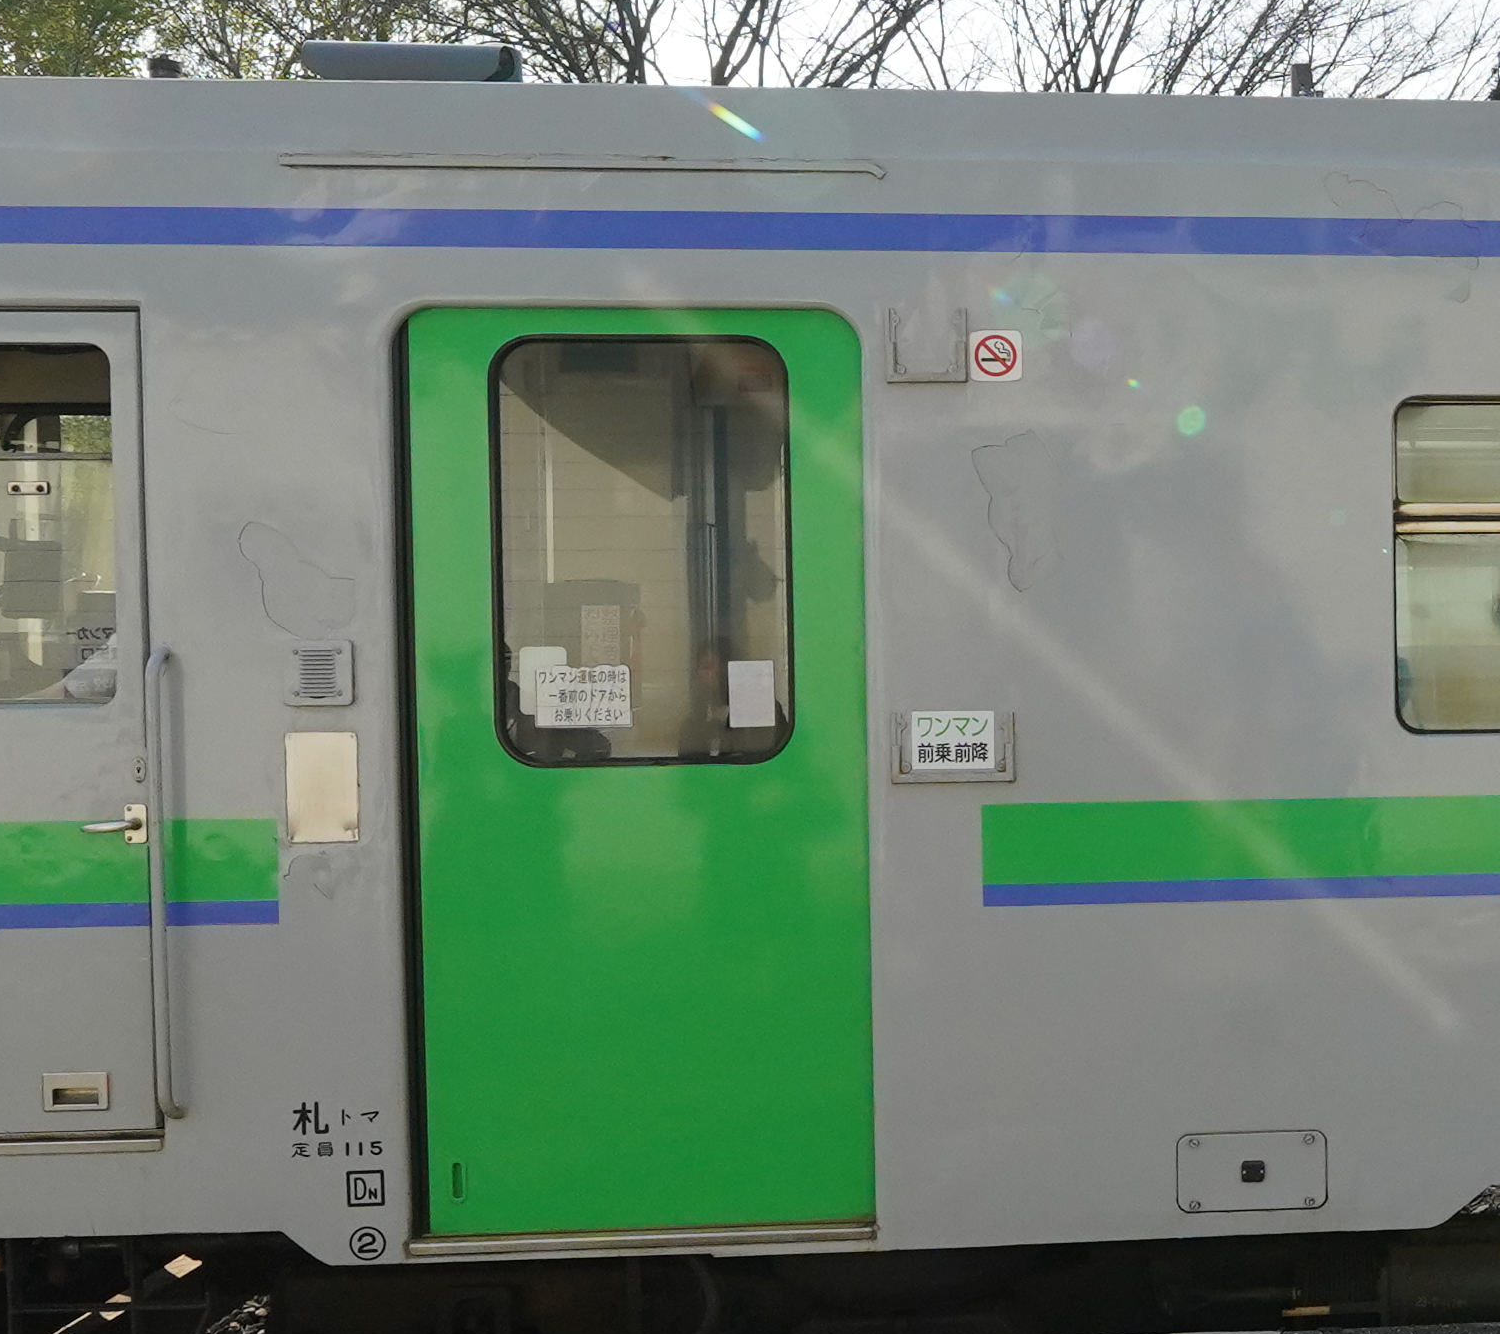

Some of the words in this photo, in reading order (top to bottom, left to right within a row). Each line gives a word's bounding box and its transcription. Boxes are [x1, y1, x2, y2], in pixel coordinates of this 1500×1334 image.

[539, 669, 628, 684] ワンマン運転の時は
[548, 688, 627, 703] 一番前のドアから
[554, 708, 623, 722] お乗りください
[917, 717, 989, 737] ワンマン
[917, 742, 989, 763] 前乗前降
